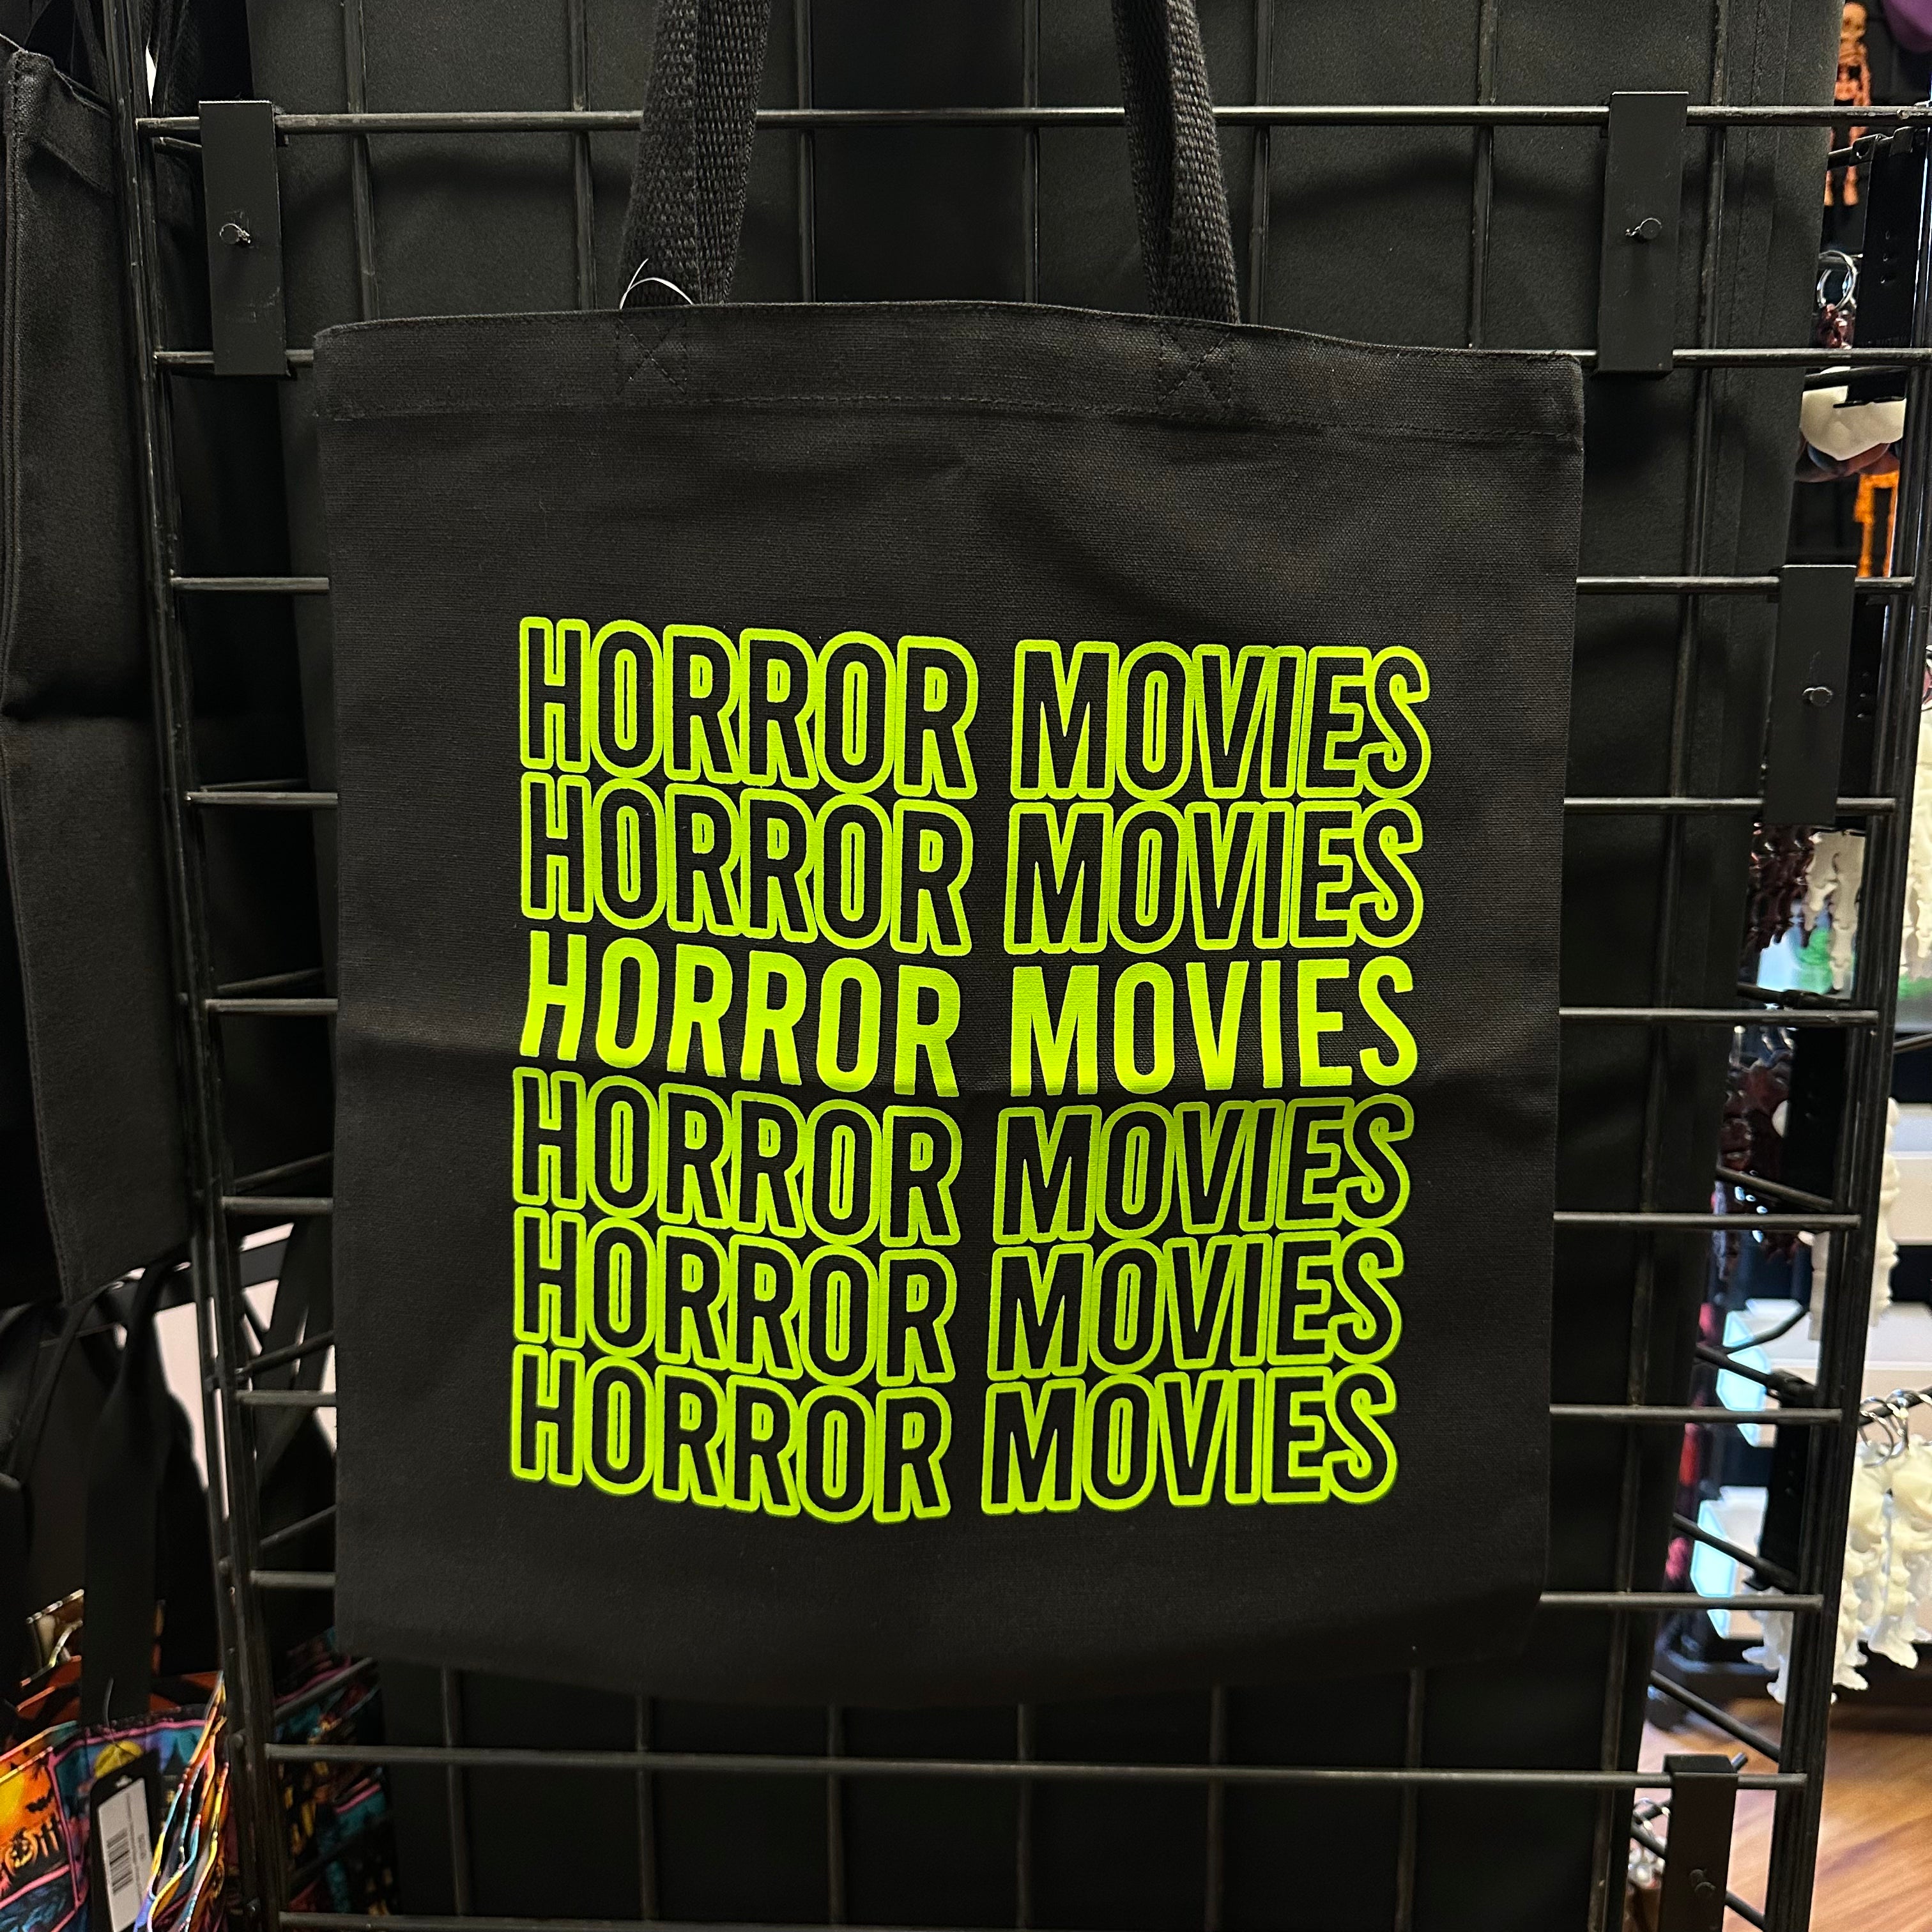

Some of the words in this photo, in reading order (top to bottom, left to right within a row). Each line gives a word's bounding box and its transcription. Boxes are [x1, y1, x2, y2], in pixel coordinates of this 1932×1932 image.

[519, 617, 978, 799] HORROR
[1011, 640, 1431, 801] MOVIES
[521, 773, 973, 955] HORROR
[1004, 800, 1425, 954] MOVIES
[519, 931, 960, 1096] HORROR
[1011, 956, 1418, 1096] MOVIES
[512, 1068, 962, 1246] HORROR
[993, 1094, 1414, 1245] MOVIES
[512, 1206, 956, 1383] HORROR
[987, 1226, 1405, 1380] MOVIES
[510, 1344, 951, 1523] HORROR
[981, 1366, 1399, 1515] MOVIES
